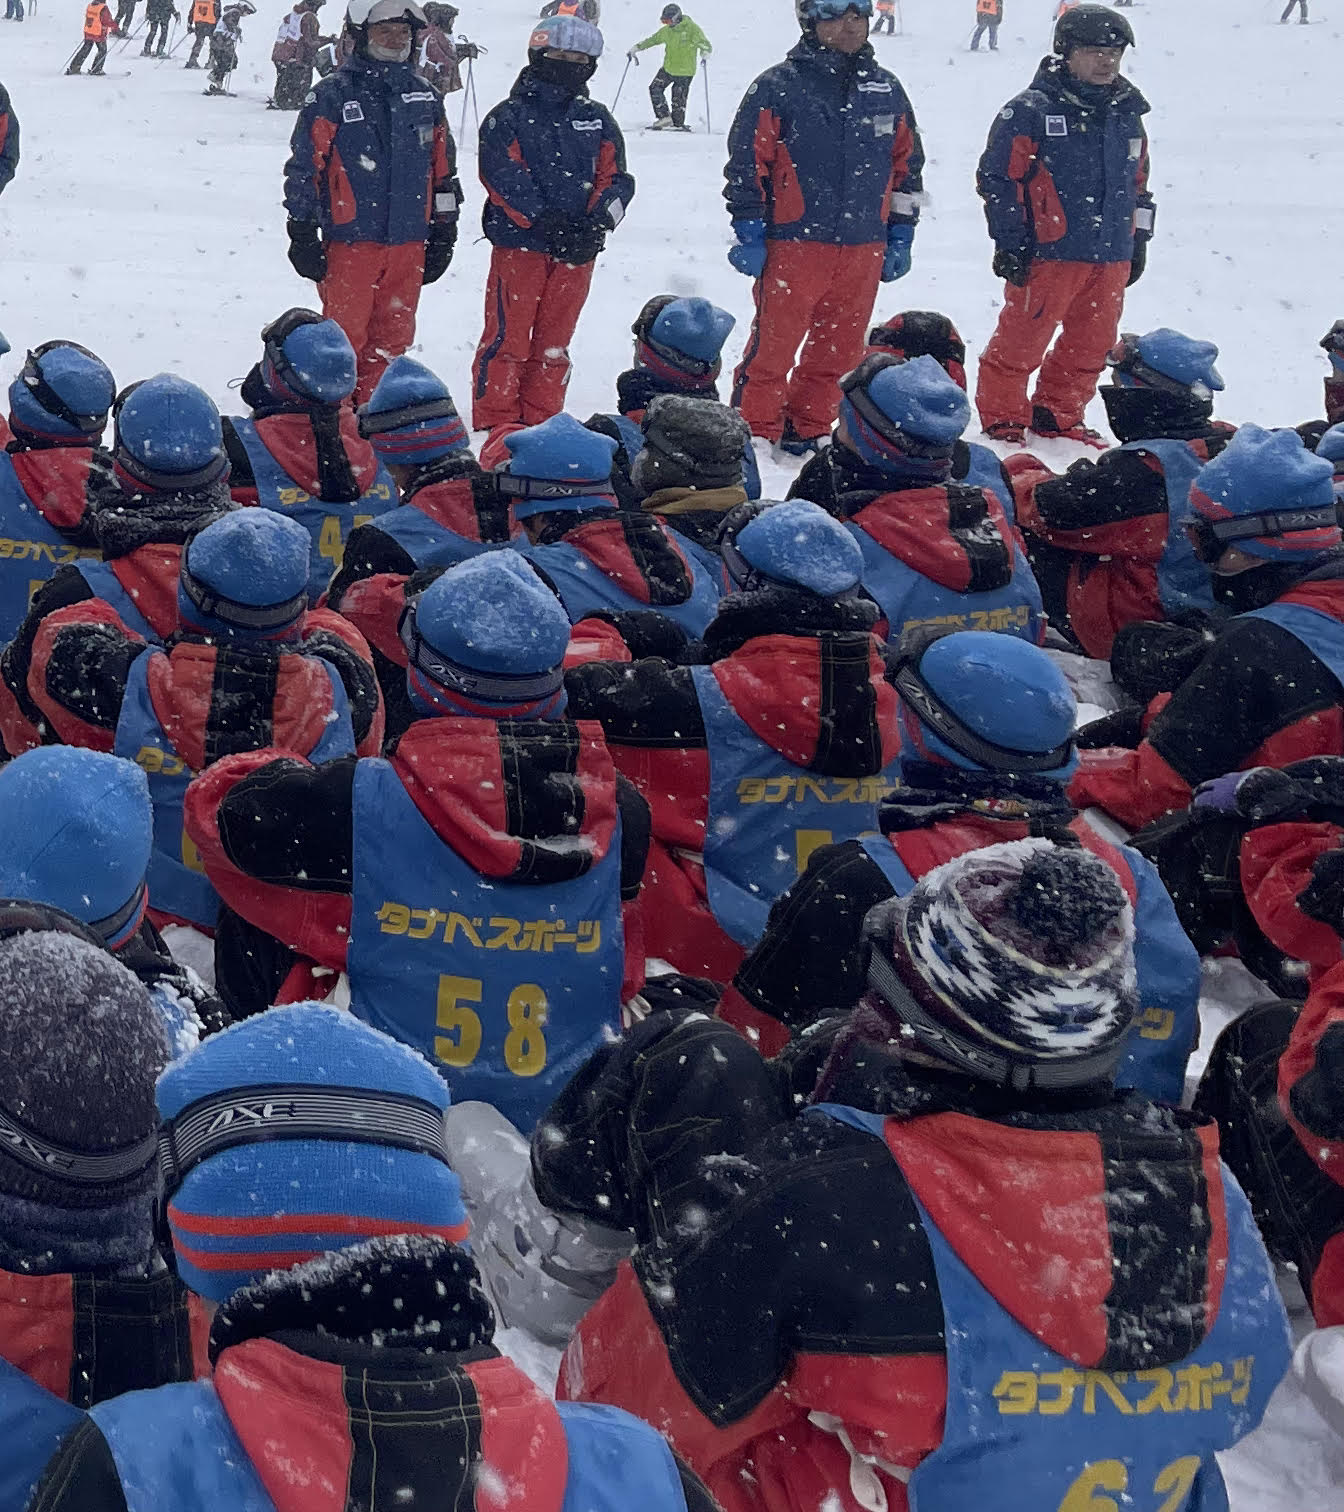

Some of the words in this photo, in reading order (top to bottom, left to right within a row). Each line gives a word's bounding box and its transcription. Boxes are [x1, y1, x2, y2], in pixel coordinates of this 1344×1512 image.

[376, 901, 601, 953] タナベスポーツ
[434, 974, 548, 1078] 58
